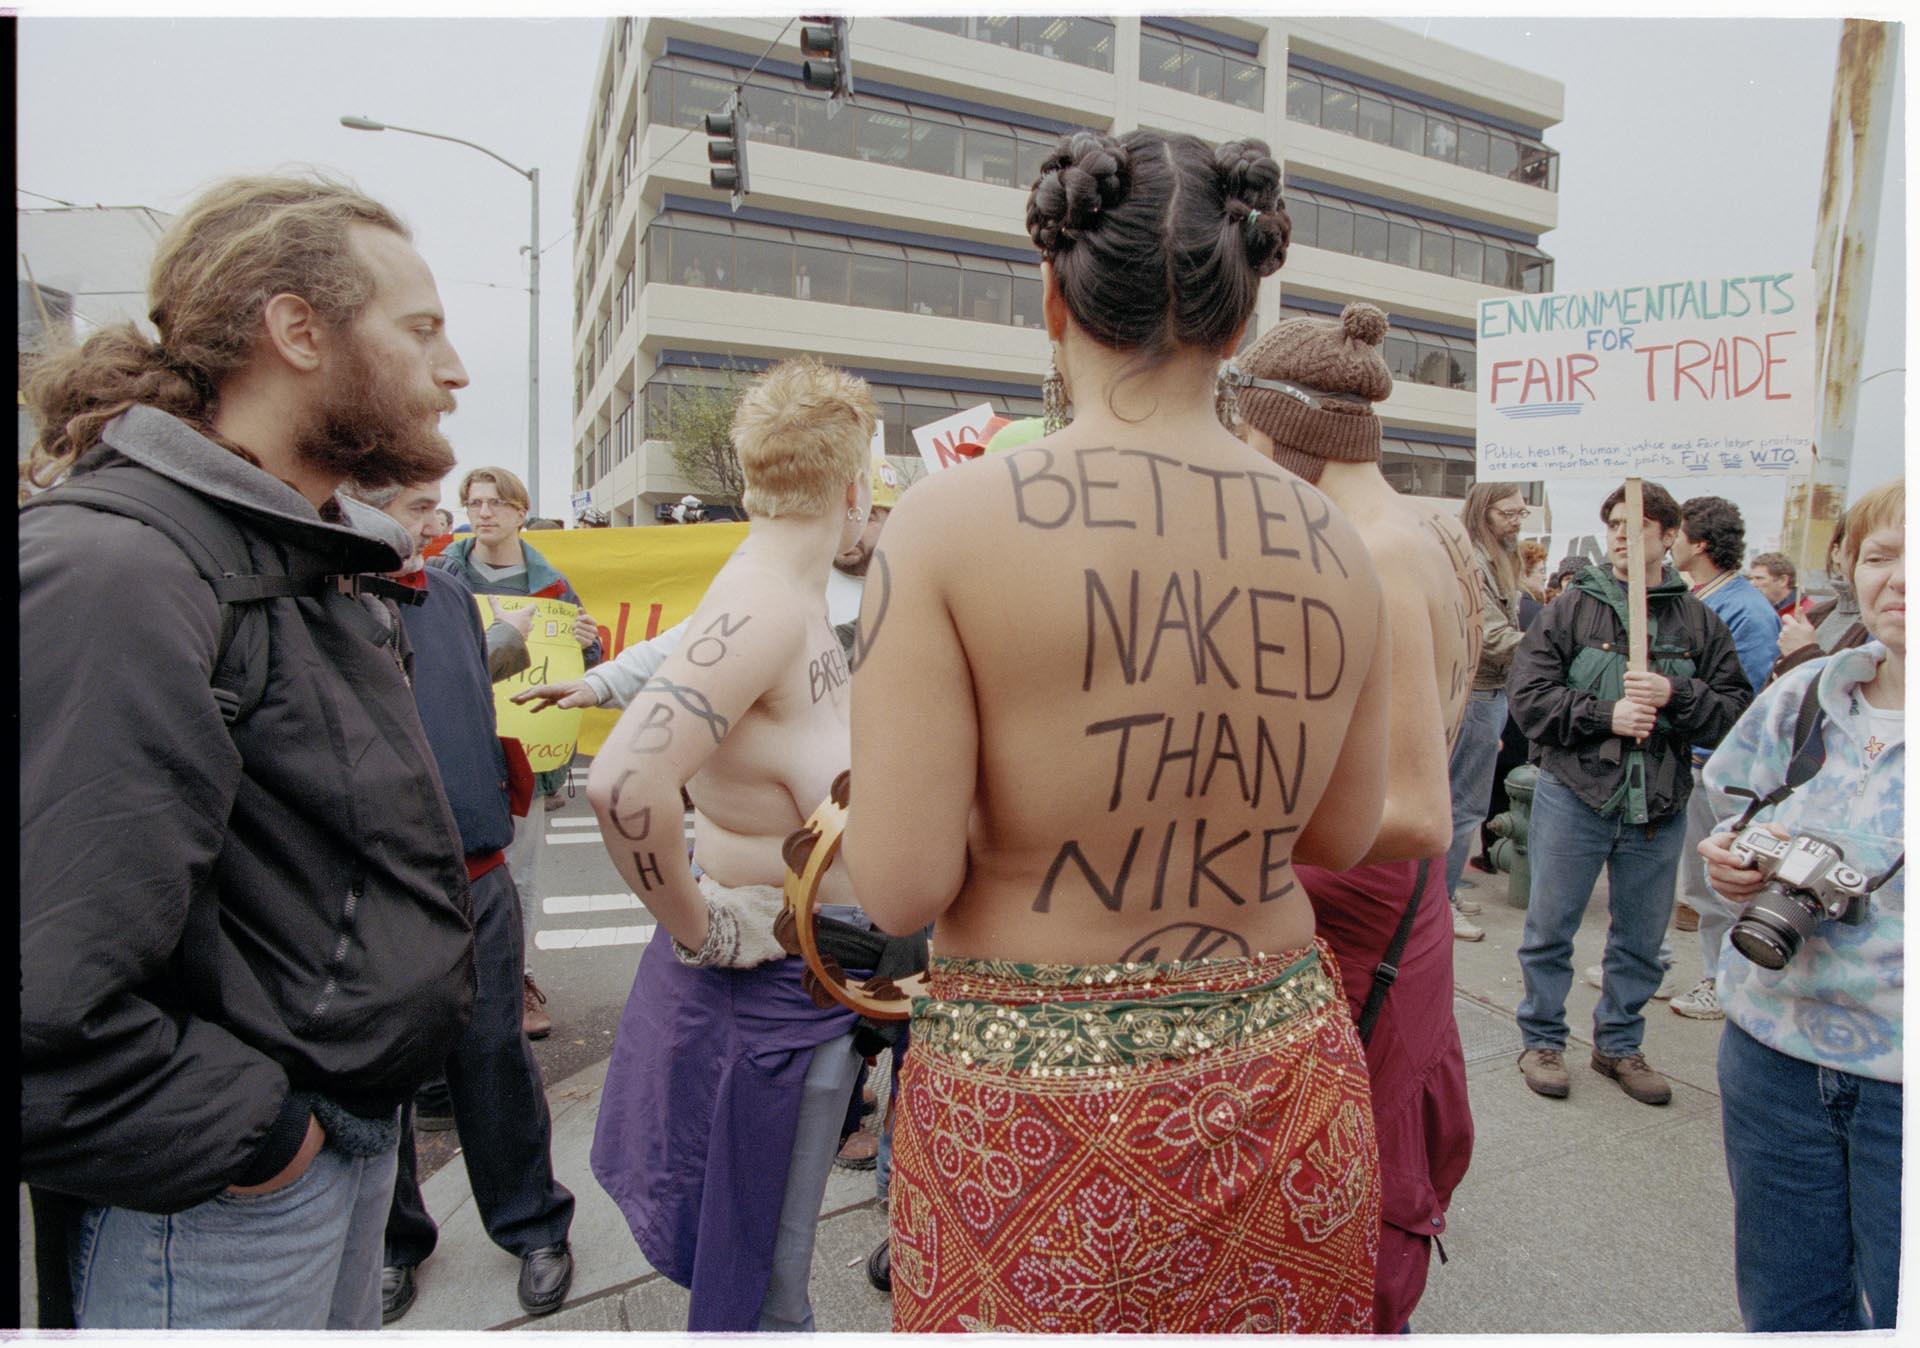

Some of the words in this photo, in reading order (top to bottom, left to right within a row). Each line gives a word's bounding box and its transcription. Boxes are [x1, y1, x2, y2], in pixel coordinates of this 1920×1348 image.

[1480, 272, 1795, 339] ENVIRONMENTALISTS
[1586, 327, 1635, 351] FOR
[1490, 353, 1600, 404] FAIR
[1634, 331, 1797, 401] TRADE
[1484, 442, 1523, 461] Public
[1580, 443, 1621, 455] human
[1671, 440, 1691, 450] and
[1488, 462, 1507, 471] are
[1511, 461, 1539, 470] more
[1544, 458, 1600, 472] important
[1681, 449, 1710, 465] FIX
[1004, 446, 1349, 579] BETTER
[1082, 568, 1345, 701] NAKED
[521, 742, 573, 765] racy
[1085, 711, 1307, 816] THAN
[1031, 818, 1300, 913] NIKE
